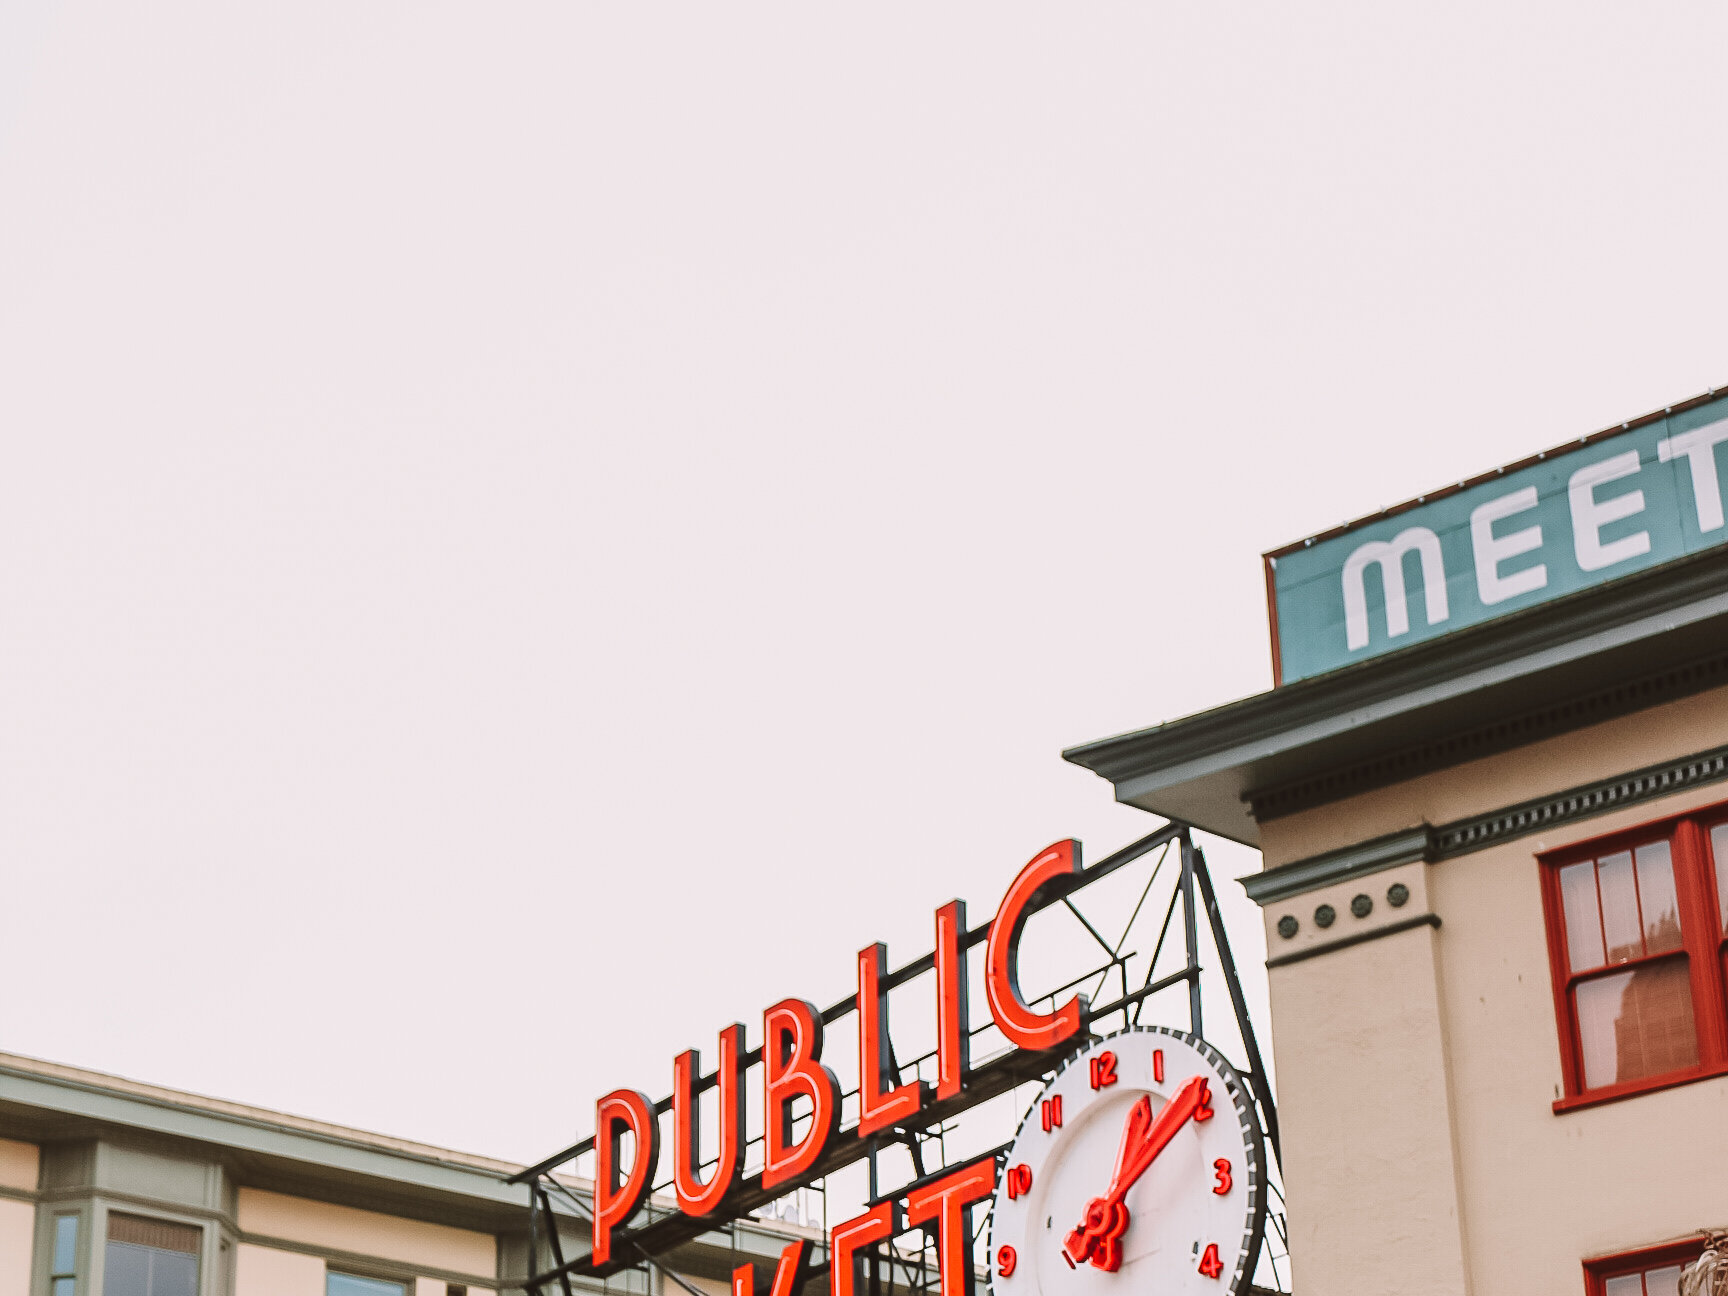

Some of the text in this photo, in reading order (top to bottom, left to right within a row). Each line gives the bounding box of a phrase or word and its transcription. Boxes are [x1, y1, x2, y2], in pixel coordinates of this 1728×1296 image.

[593, 838, 1086, 1266] PUBLIC
[1153, 1050, 1164, 1083] 1
[1090, 1051, 1118, 1090] 12
[1042, 1095, 1062, 1132] 11
[1007, 1164, 1033, 1200] 10
[1213, 1158, 1232, 1196] 3
[997, 1245, 1017, 1278] 9
[1198, 1244, 1224, 1279] 4
